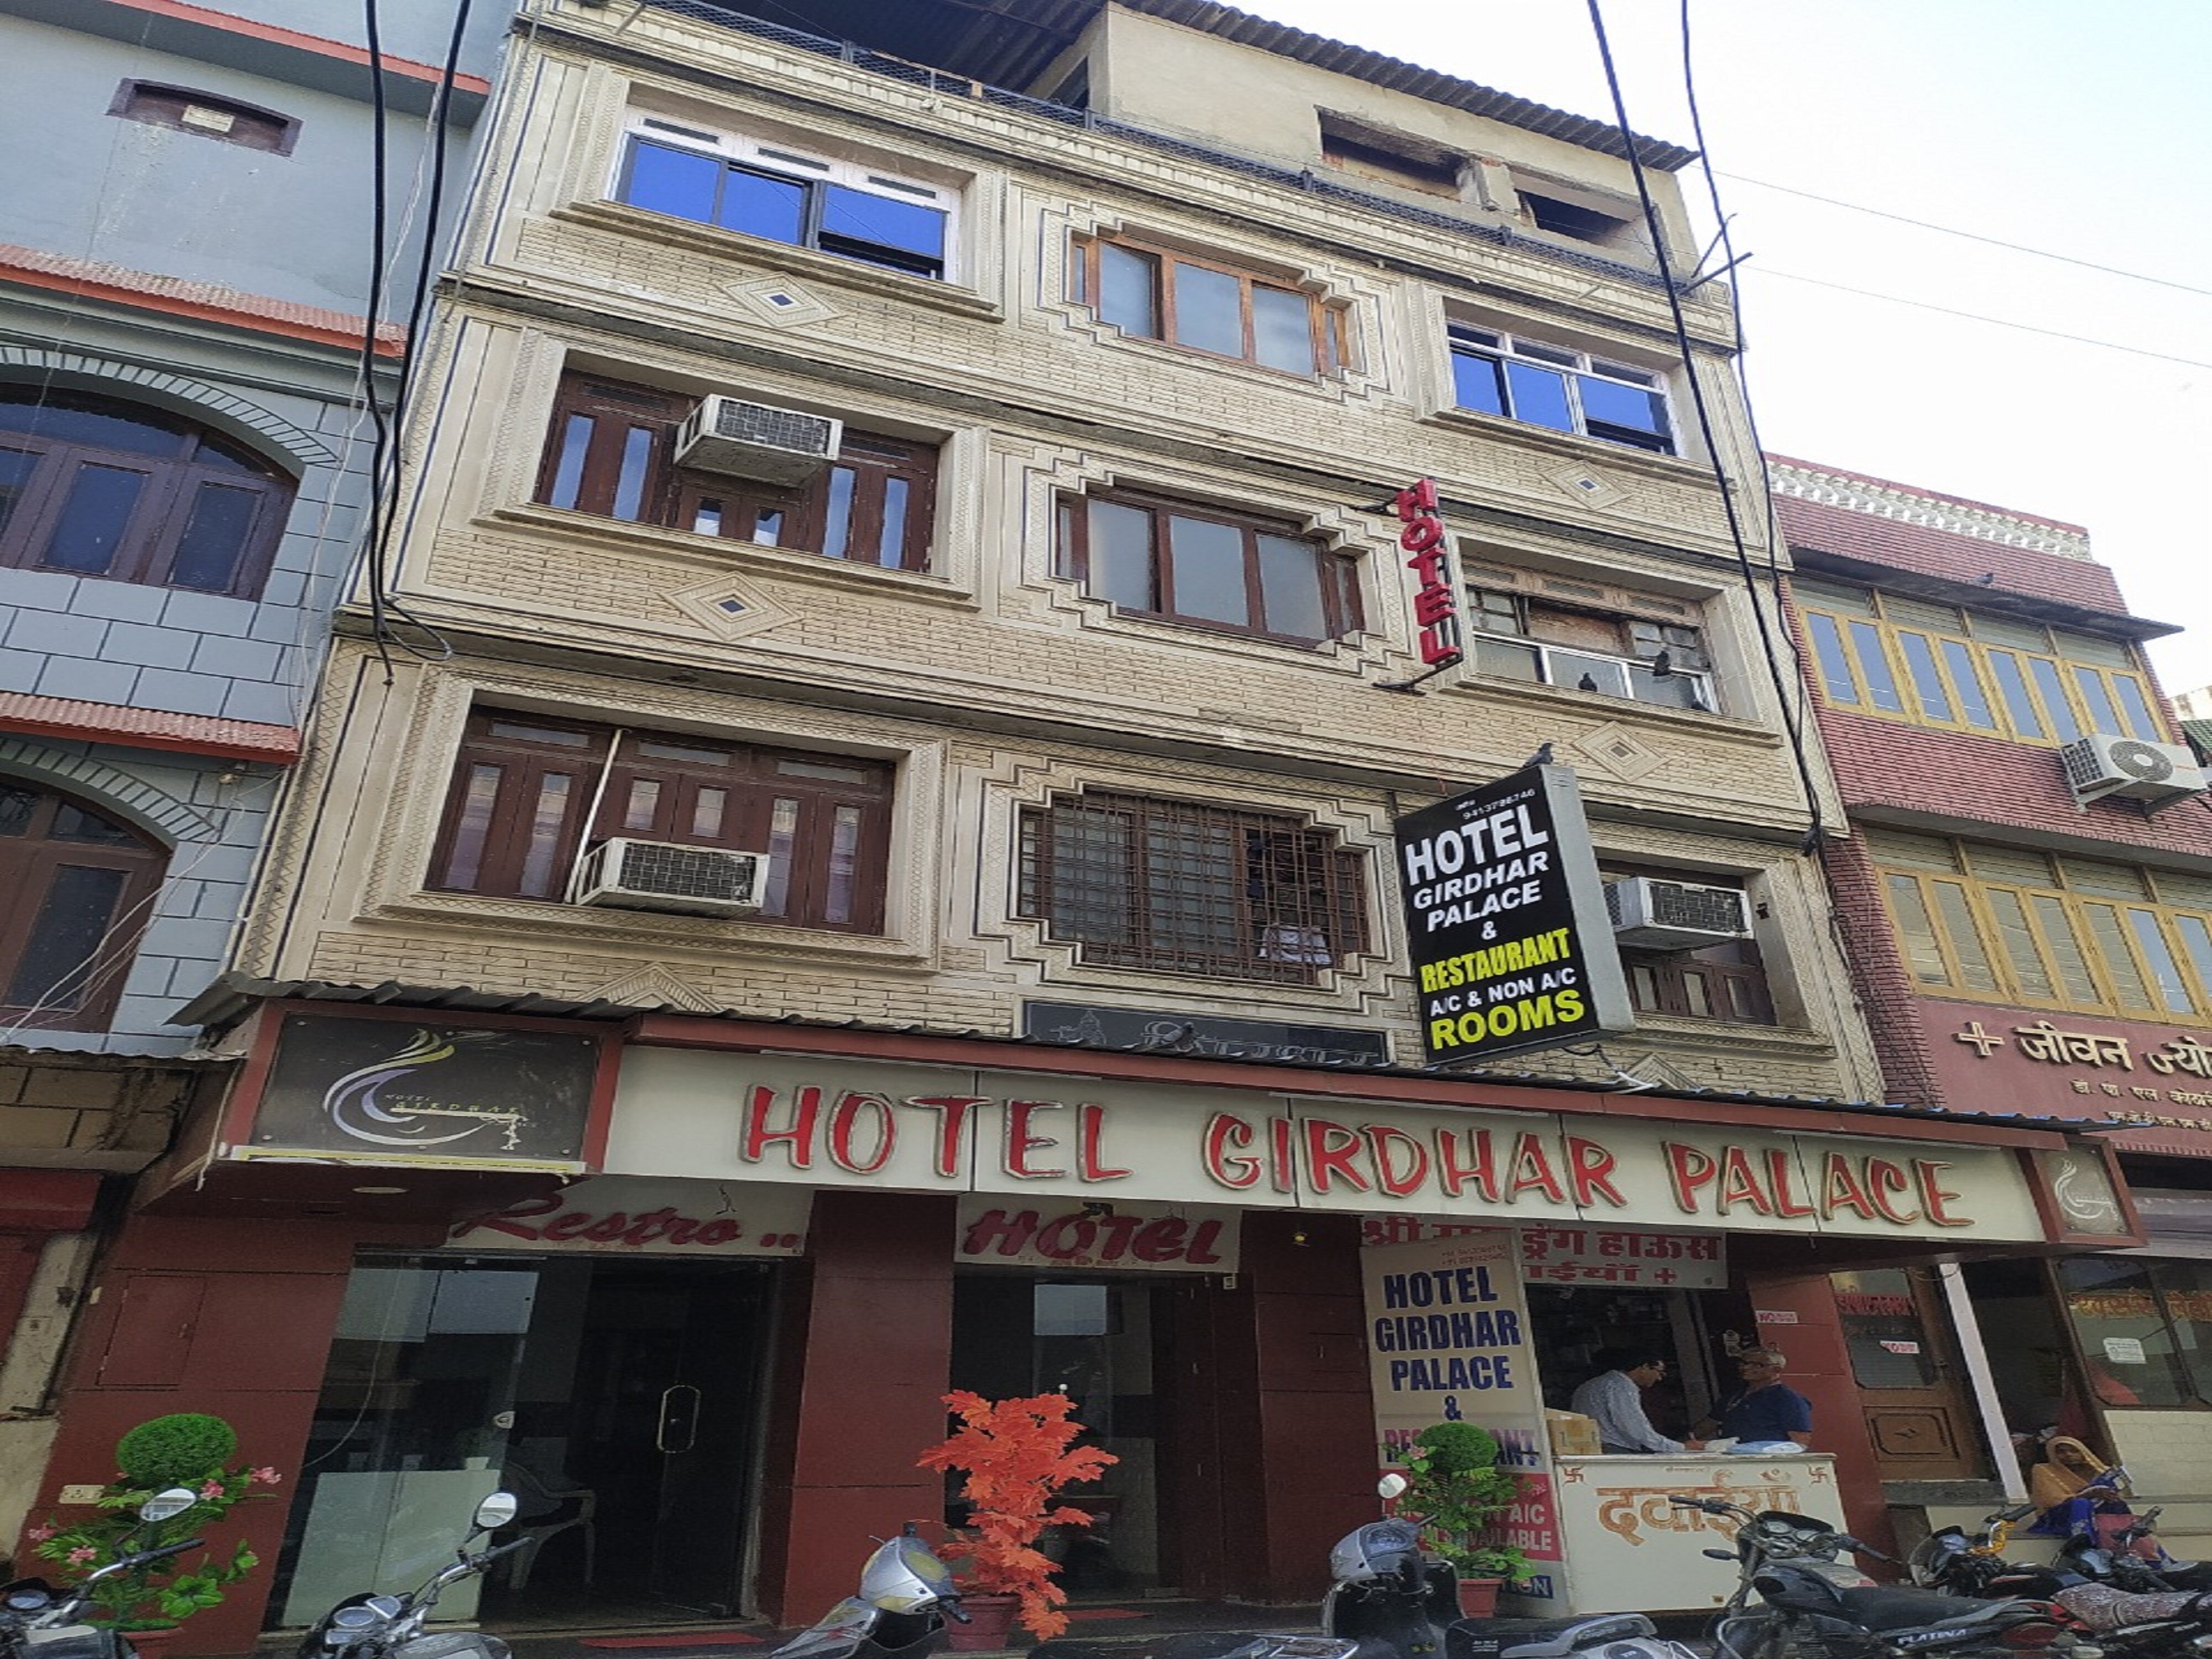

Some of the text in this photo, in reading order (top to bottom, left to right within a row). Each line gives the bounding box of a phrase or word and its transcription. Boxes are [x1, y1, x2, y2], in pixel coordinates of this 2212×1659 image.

[1395, 478, 1462, 665] HOTEL
[1405, 804, 1549, 886] HOTEL
[1413, 851, 1548, 910] GIRDHAR
[1427, 880, 1542, 932] PALACE
[1481, 921, 1498, 940] &
[1420, 927, 1571, 993] RESTAURANT
[1430, 968, 1577, 1017] A/C & NON A/C
[1430, 989, 1585, 1050] ROOMS
[2012, 1020, 2212, 1078] जीवन ज्यो
[739, 1084, 1975, 1227] HOTEL GIRDHAR PALACE
[453, 1194, 742, 1246] Restro
[1383, 1265, 1499, 1309] HOTEL
[1375, 1310, 1521, 1353] GIRDHAR
[1390, 1355, 1514, 1391] PALACE
[1444, 1395, 1464, 1421] &
[1897, 1629, 1966, 1645] PLATINA
